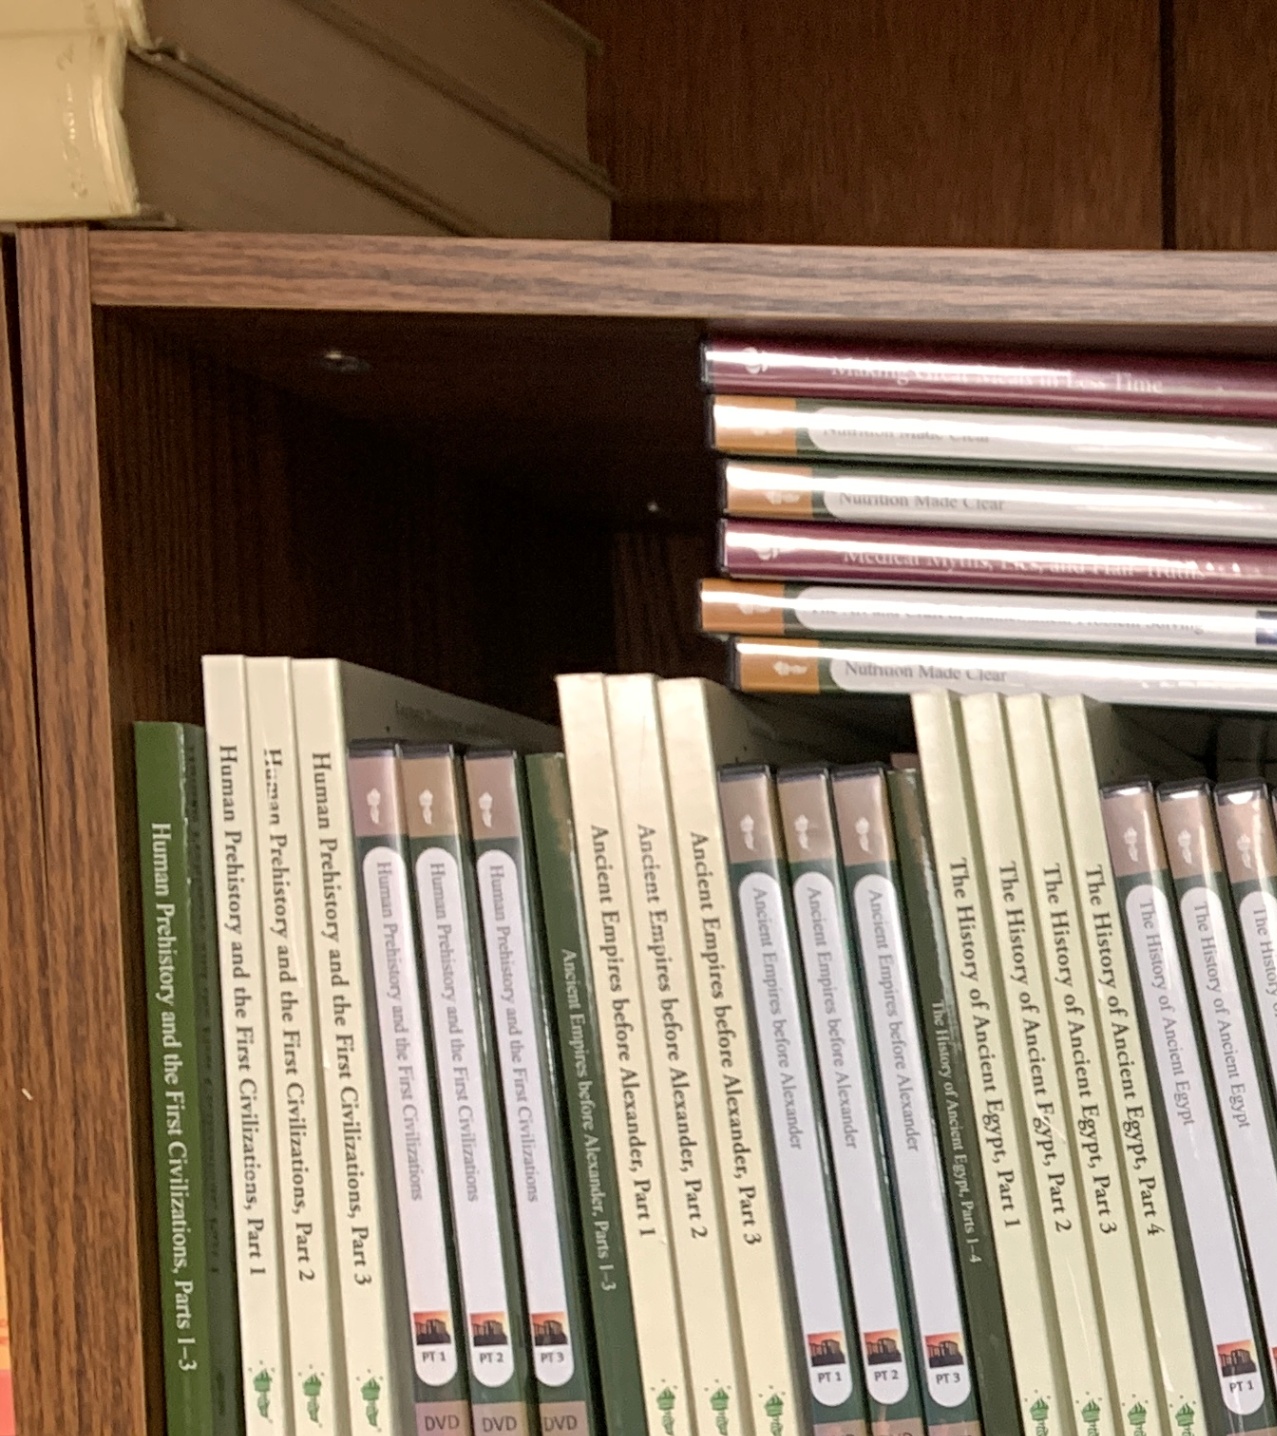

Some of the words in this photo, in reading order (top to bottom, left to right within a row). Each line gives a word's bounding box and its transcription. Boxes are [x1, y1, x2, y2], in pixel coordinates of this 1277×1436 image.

[914, 492, 958, 511] Made
[150, 822, 173, 898] Human
[689, 831, 715, 912] Ancient
[1084, 863, 1107, 906] The
[154, 902, 179, 1008] Prehistory
[699, 916, 727, 1001] Empires
[1091, 911, 1117, 990] History
[160, 1010, 184, 1049] and
[1106, 994, 1130, 1018] of
[712, 1004, 738, 1069] before
[162, 1052, 185, 1086] the
[1110, 1021, 1137, 1101] Ancient
[164, 1089, 187, 1137] First
[721, 1073, 753, 1180] Alexander,
[1121, 1104, 1149, 1171] Egypt,
[166, 1140, 193, 1275] Civilizations,
[737, 1184, 758, 1228] Part
[1137, 1175, 1158, 1219] Part
[742, 1232, 763, 1246] 3
[1146, 1222, 1166, 1237] 4
[173, 1279, 195, 1331] Parts
[421, 1351, 436, 1363] PT
[424, 1414, 461, 1432] DVD
